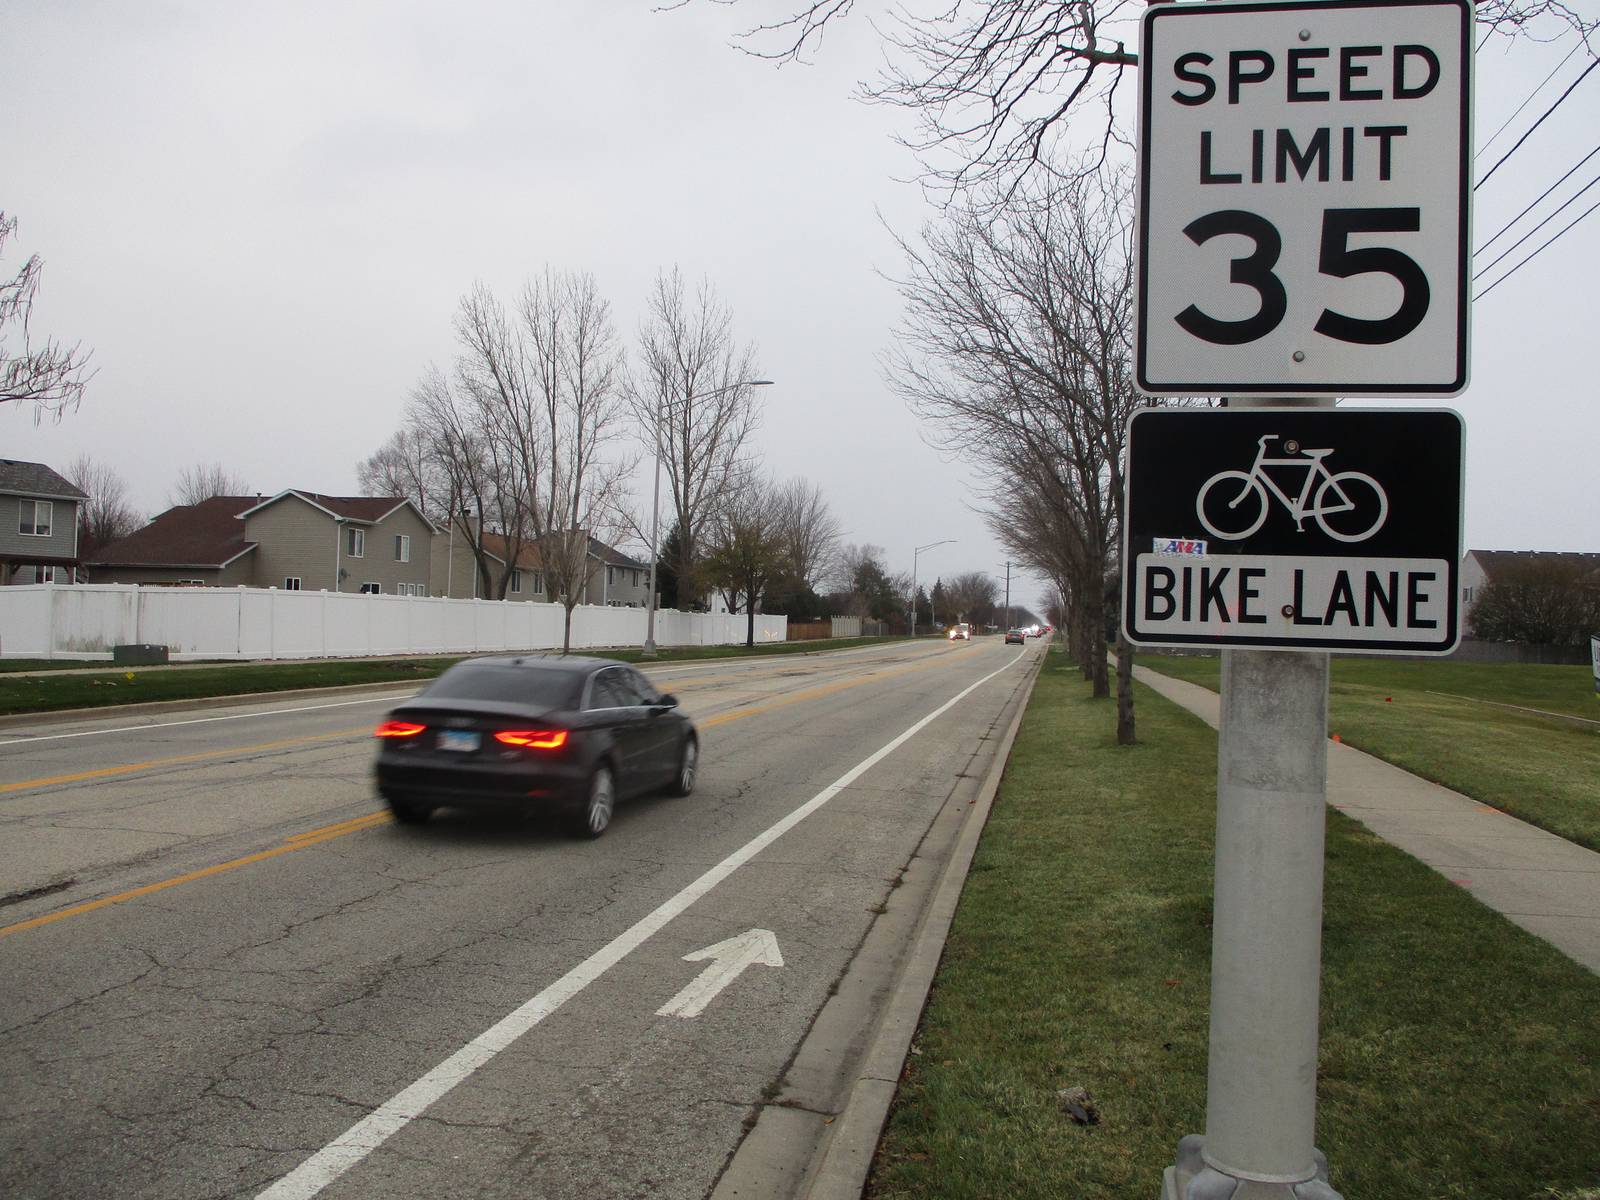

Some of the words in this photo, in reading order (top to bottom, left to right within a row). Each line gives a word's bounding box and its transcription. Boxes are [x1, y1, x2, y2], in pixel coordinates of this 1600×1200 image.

[1170, 44, 1441, 107] SPEED
[1199, 125, 1408, 185] LIMIT
[1173, 206, 1431, 346] 35
[1144, 565, 1268, 625] BIKE
[1293, 568, 1438, 630] LANE
